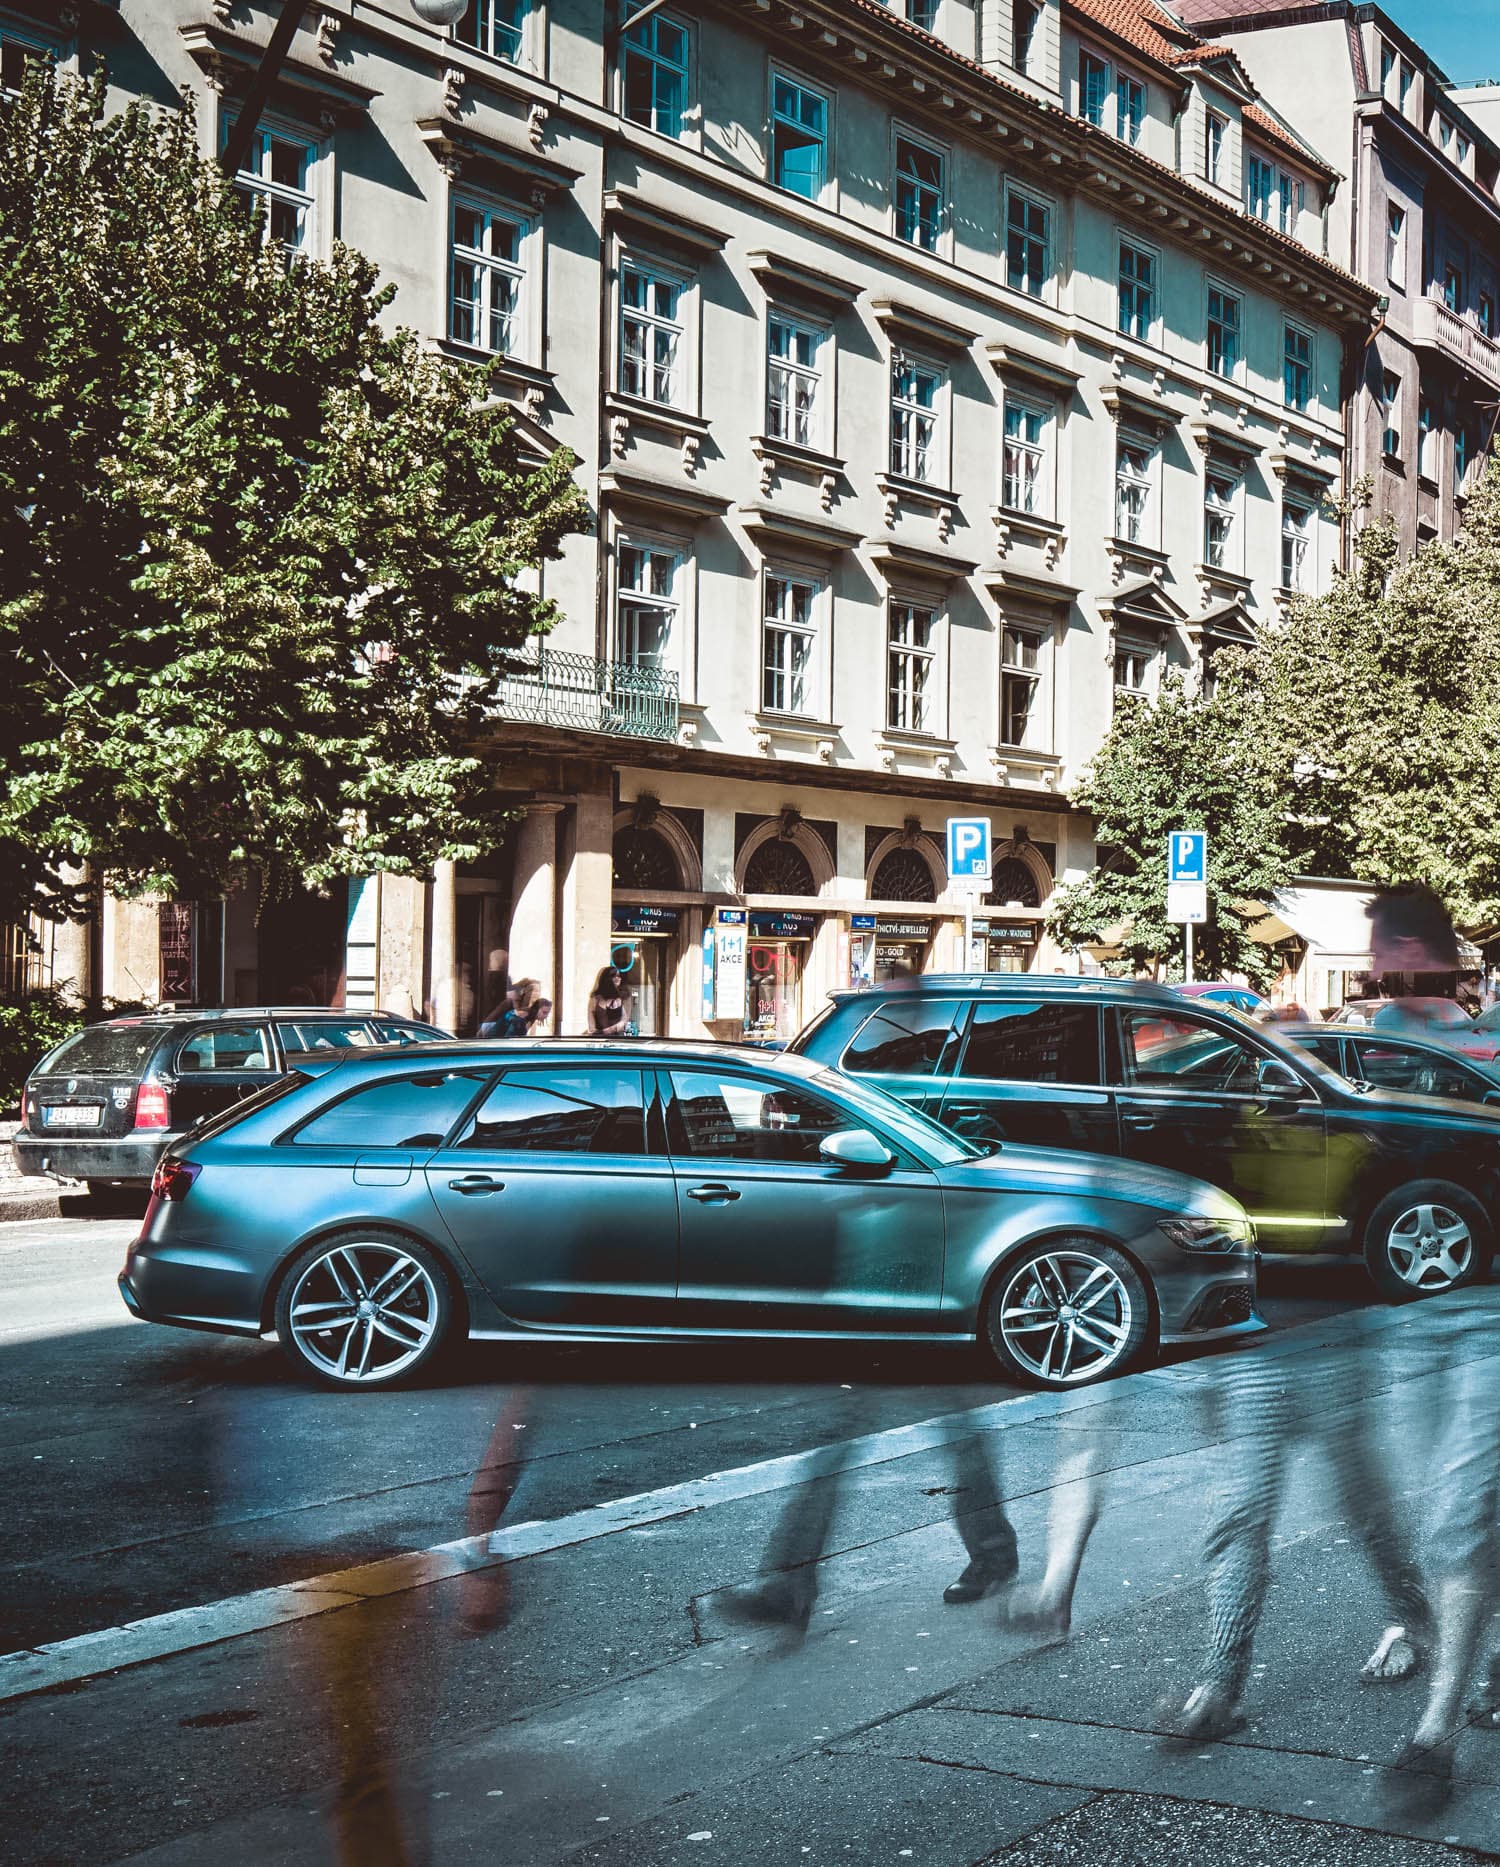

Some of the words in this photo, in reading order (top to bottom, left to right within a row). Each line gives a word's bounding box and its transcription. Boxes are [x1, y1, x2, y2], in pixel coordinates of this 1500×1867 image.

[956, 826, 982, 861] P
[1179, 837, 1194, 865] P
[720, 936, 742, 952] 1+1
[720, 954, 742, 963] AKCE
